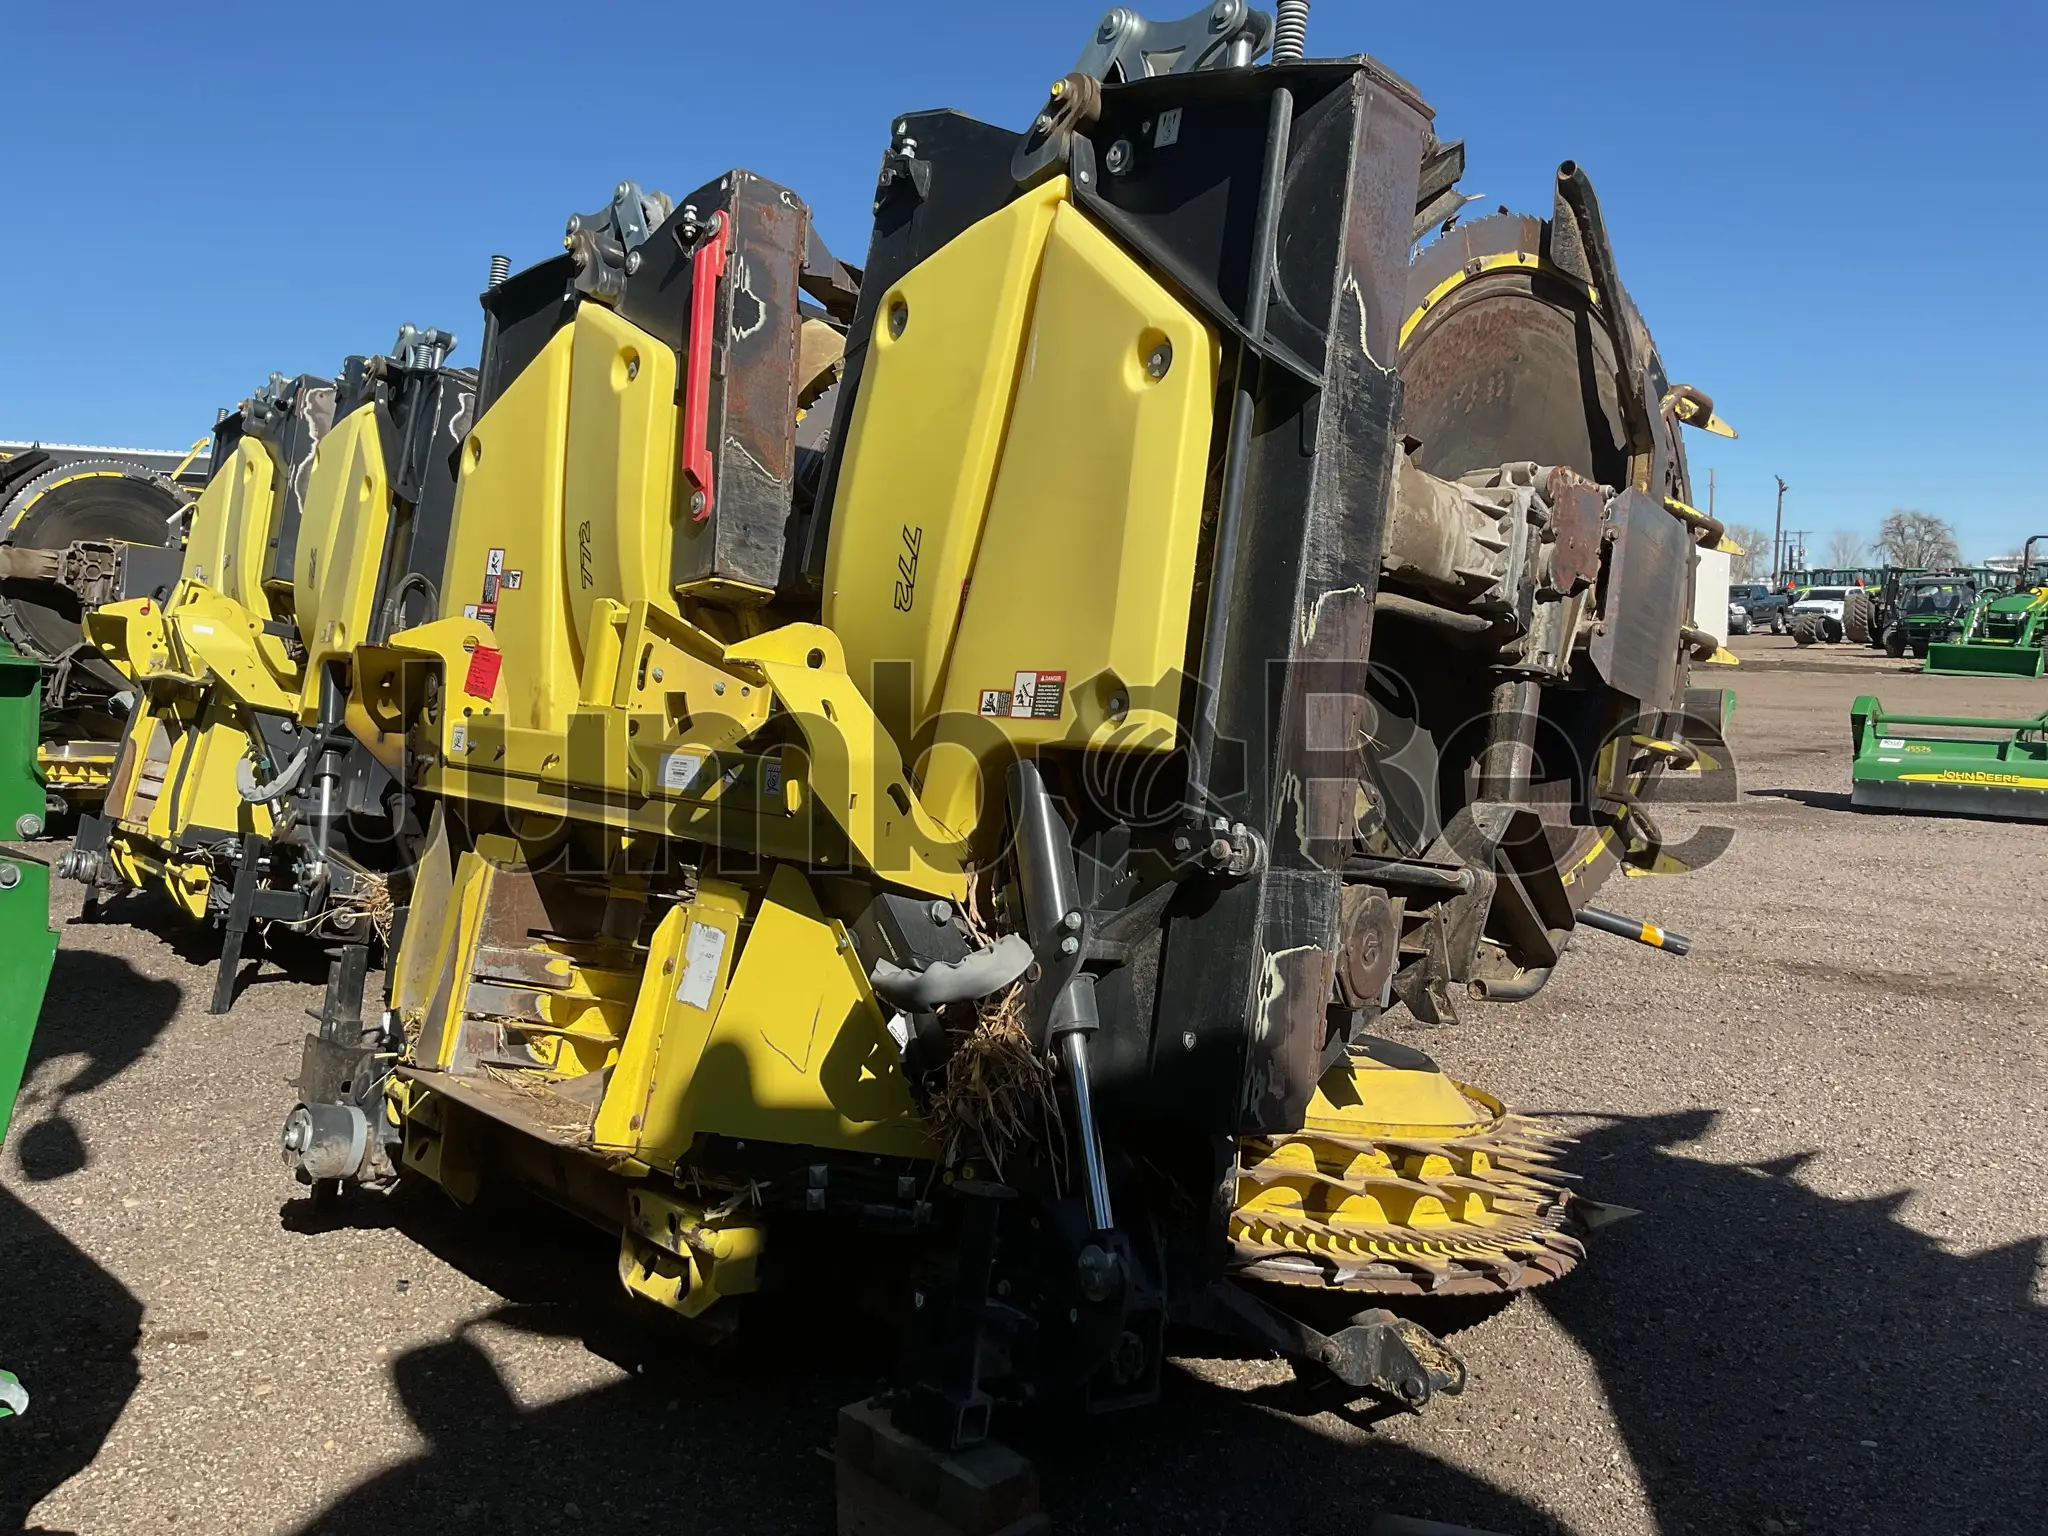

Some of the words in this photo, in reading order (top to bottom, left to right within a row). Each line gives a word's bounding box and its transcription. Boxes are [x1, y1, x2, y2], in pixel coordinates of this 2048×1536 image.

[894, 525, 922, 612] 772
[1938, 768, 1976, 781] JOHN
[1976, 771, 2021, 784] DEERE
